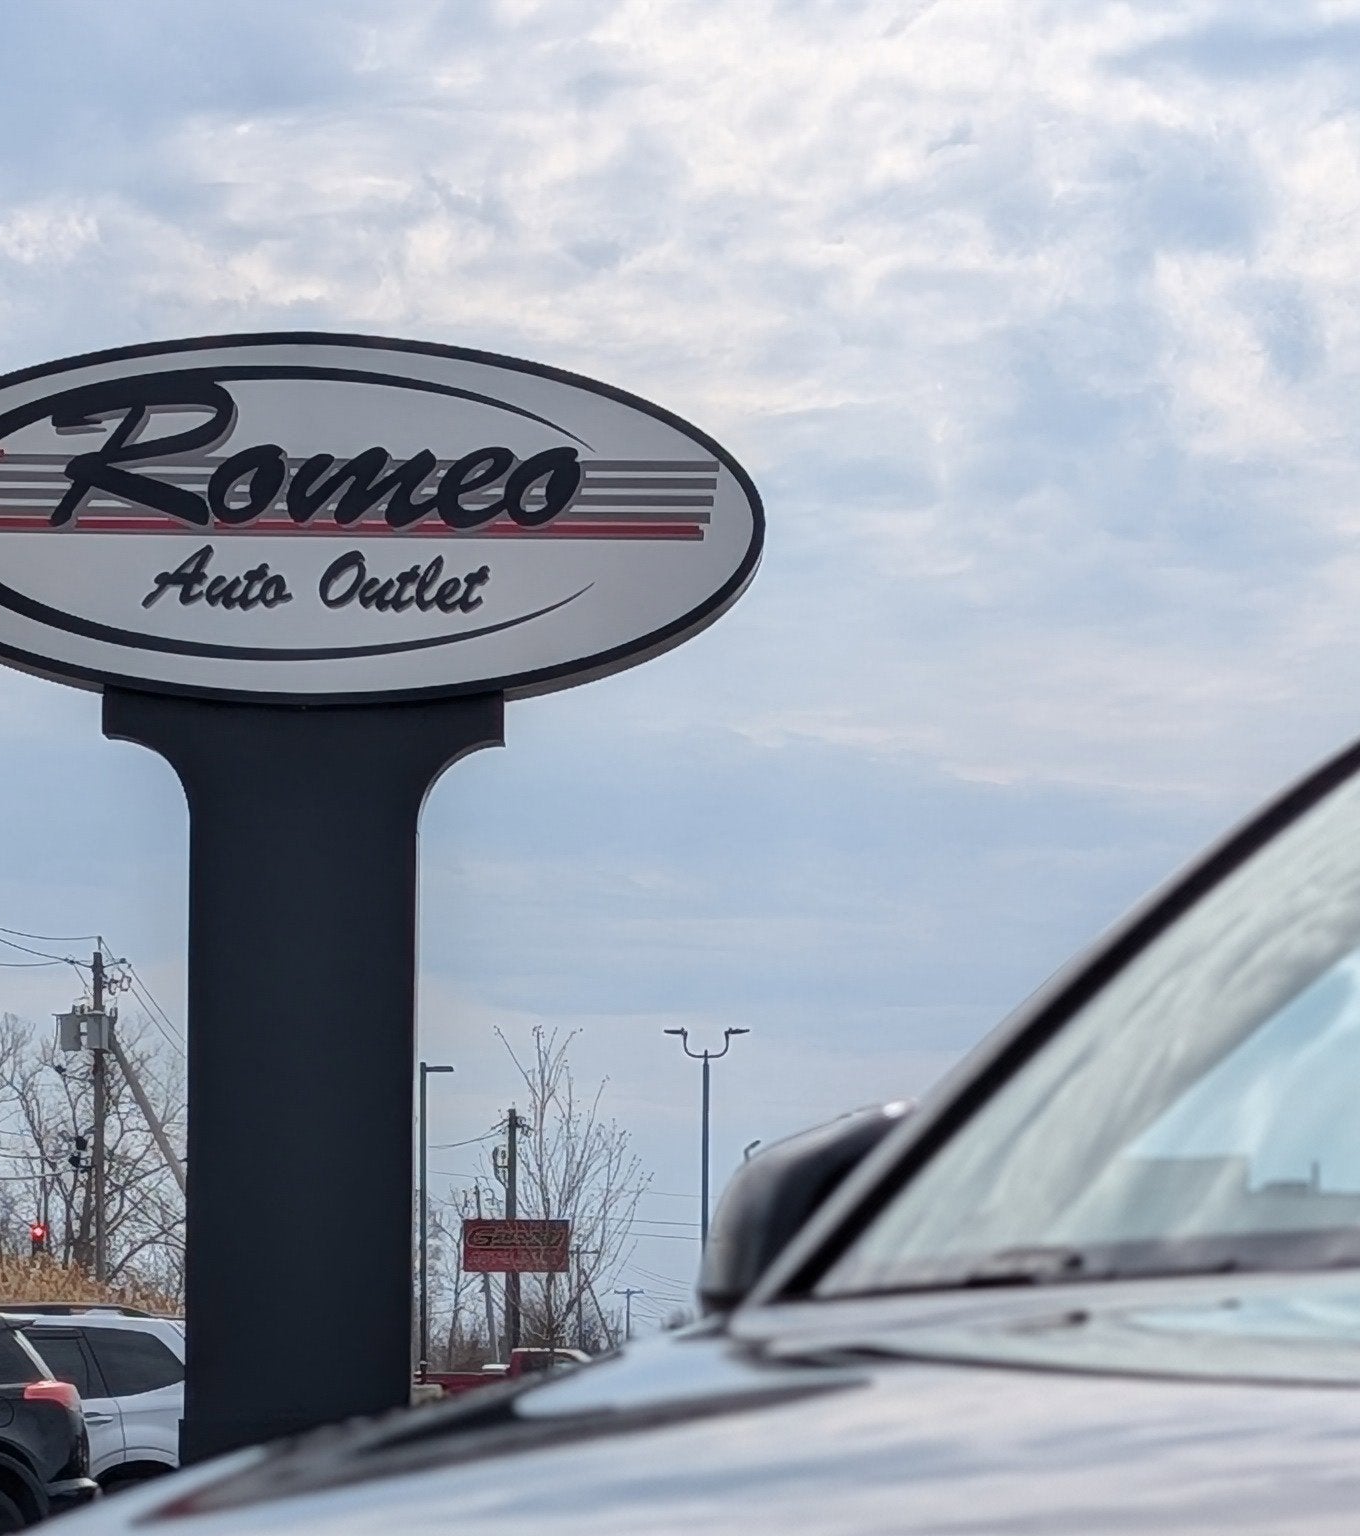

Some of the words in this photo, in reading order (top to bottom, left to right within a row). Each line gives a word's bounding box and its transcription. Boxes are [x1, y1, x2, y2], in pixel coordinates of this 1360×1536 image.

[48, 378, 583, 530] Romeo
[142, 544, 293, 610] Auto
[318, 549, 490, 614] Outlet
